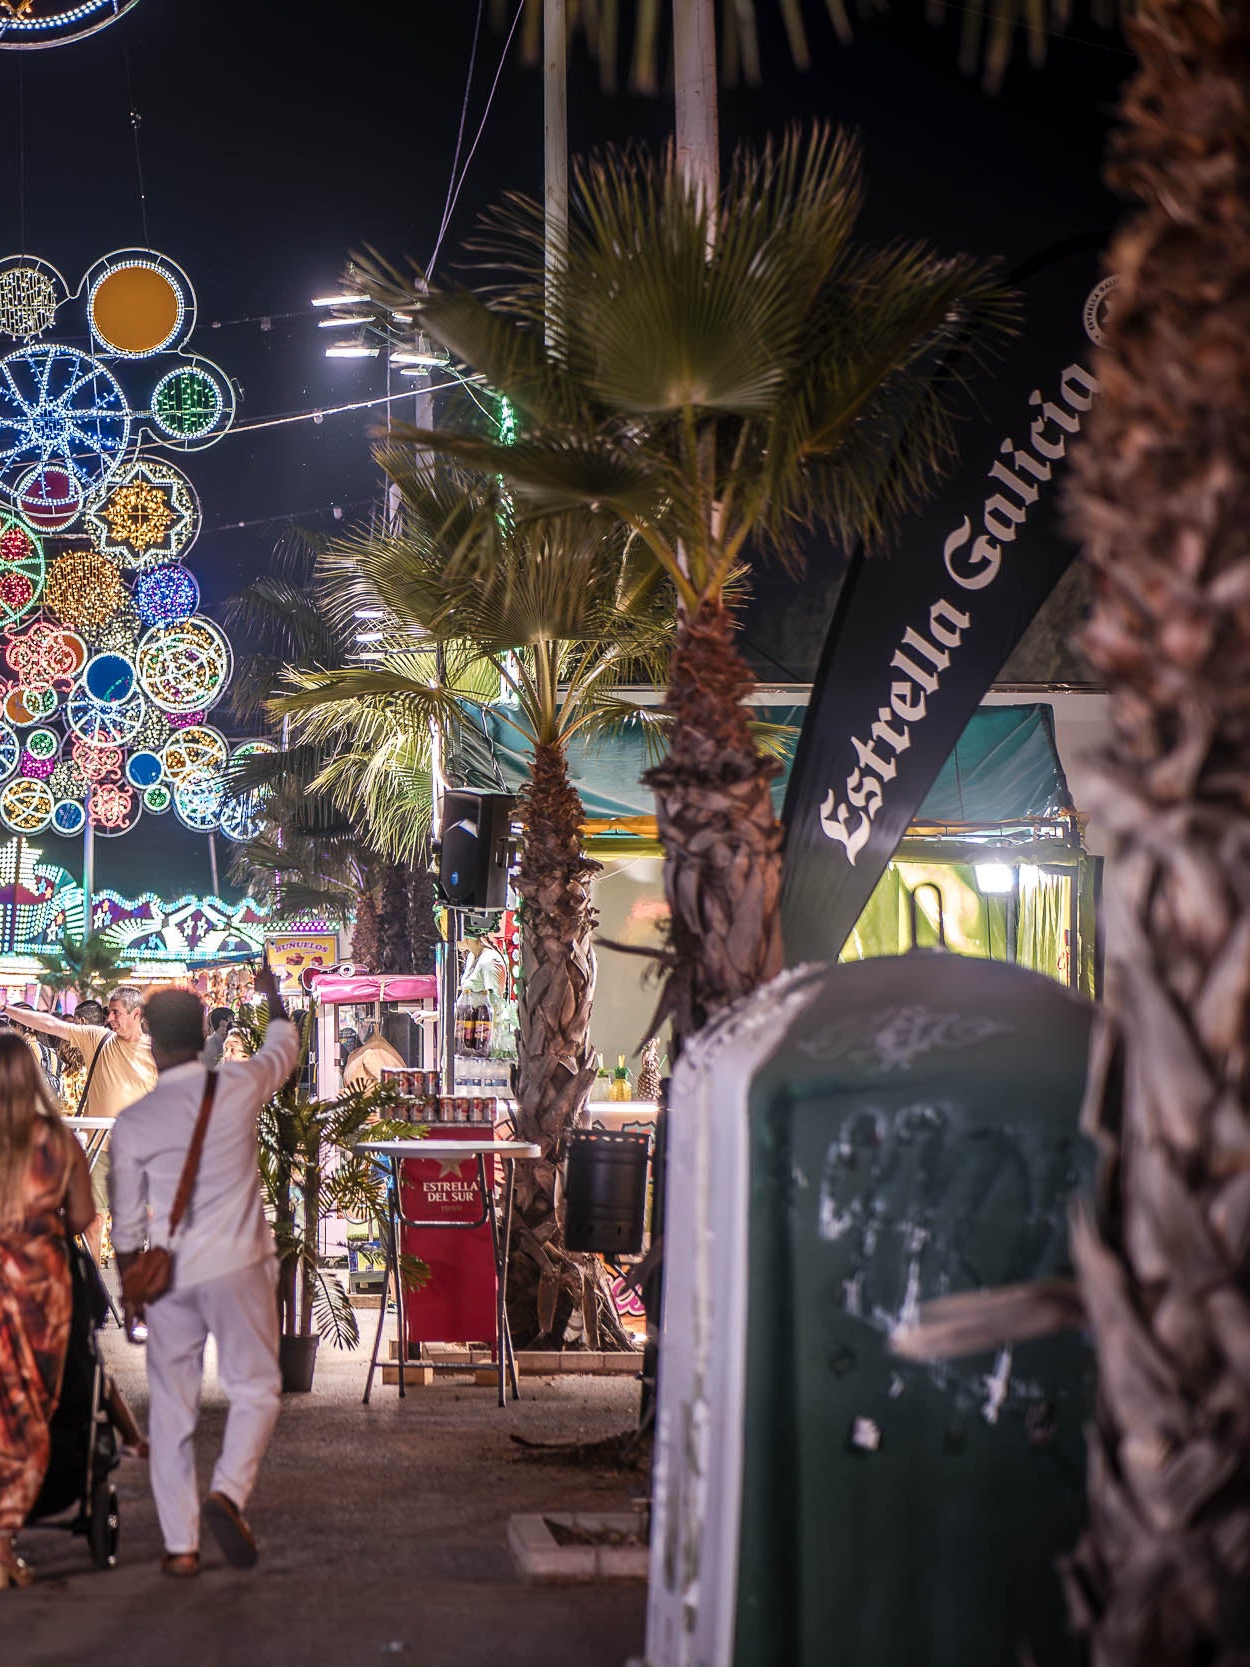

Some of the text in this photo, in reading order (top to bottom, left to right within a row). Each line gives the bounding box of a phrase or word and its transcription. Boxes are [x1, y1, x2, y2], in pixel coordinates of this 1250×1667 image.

[820, 363, 1101, 867] Estrella Galicia
[275, 941, 329, 953] BUÑUELOS
[423, 1182, 478, 1191] ESTRELLA
[427, 1192, 474, 1202] DEL SUR
